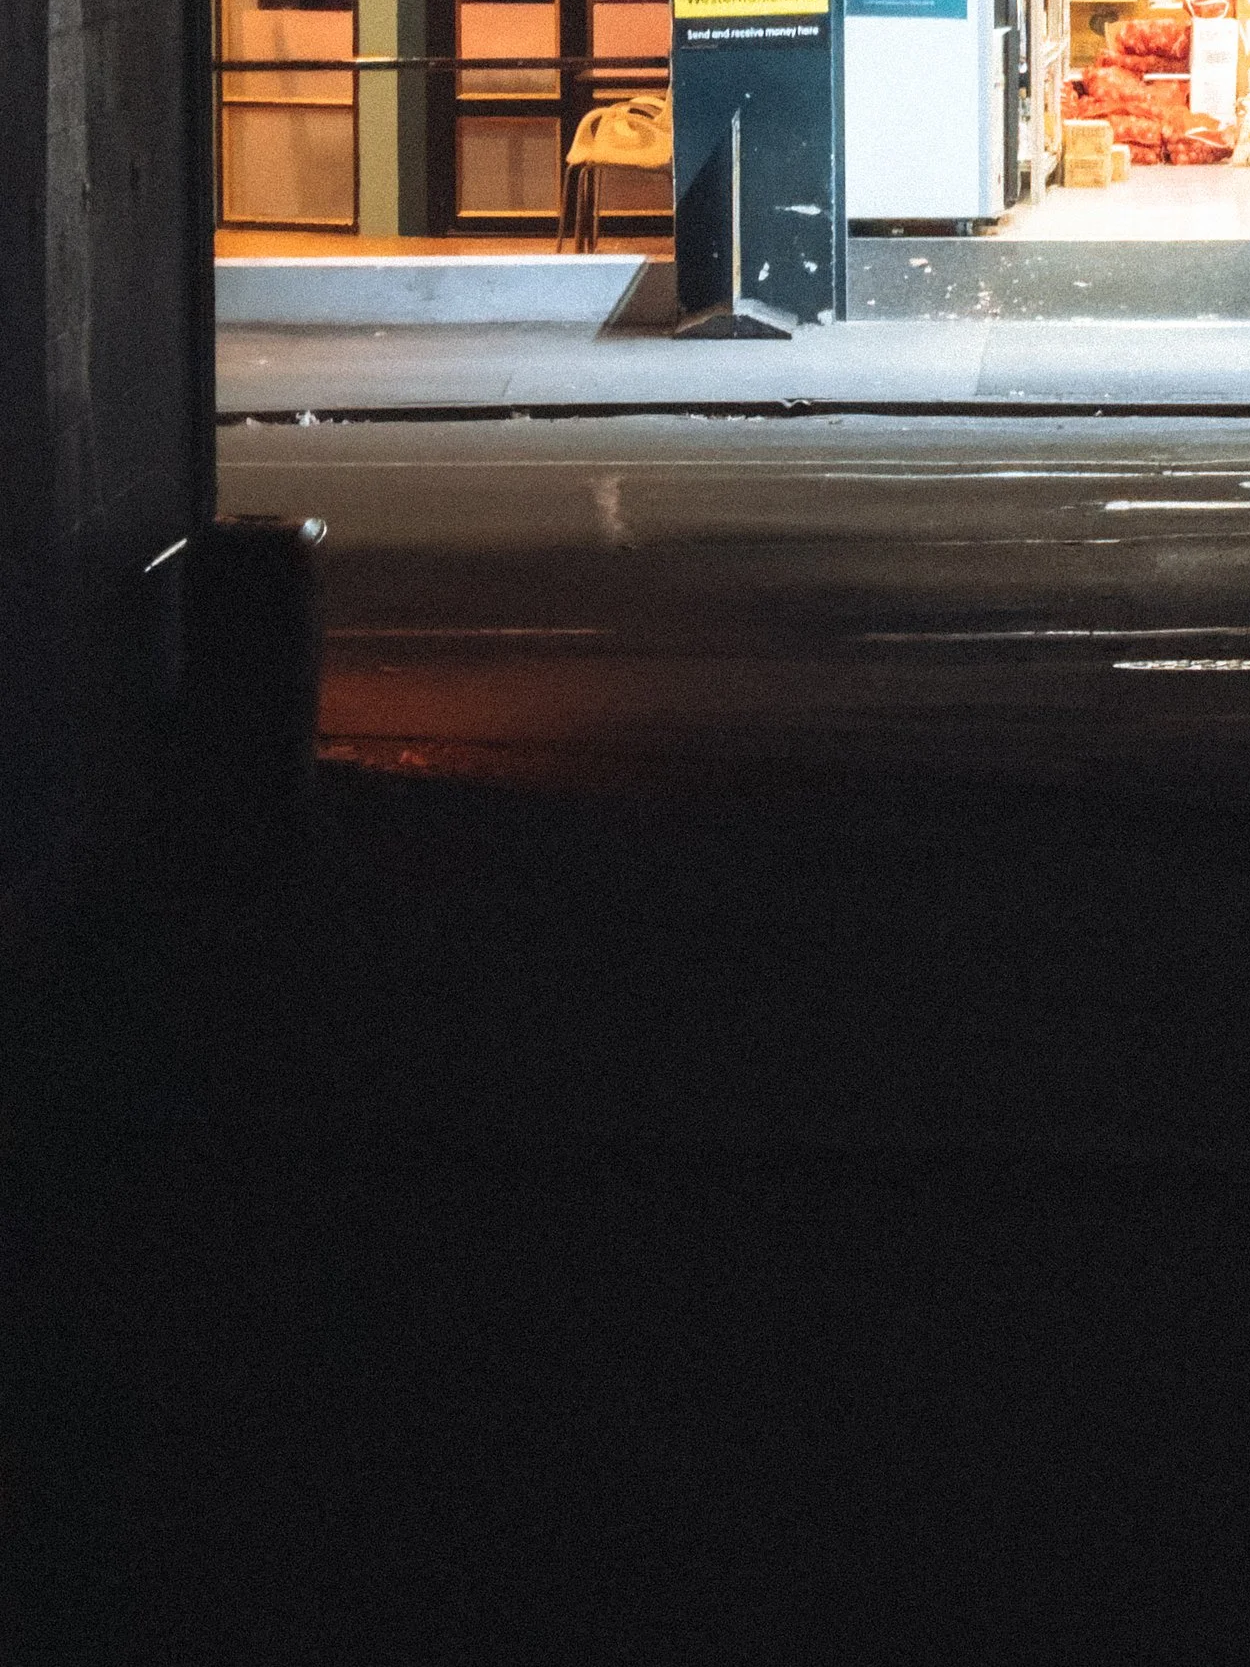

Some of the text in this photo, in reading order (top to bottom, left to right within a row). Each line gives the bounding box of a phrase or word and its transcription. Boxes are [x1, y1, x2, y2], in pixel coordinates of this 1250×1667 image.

[711, 27, 730, 40] and
[731, 26, 764, 39] receive
[765, 26, 797, 39] money
